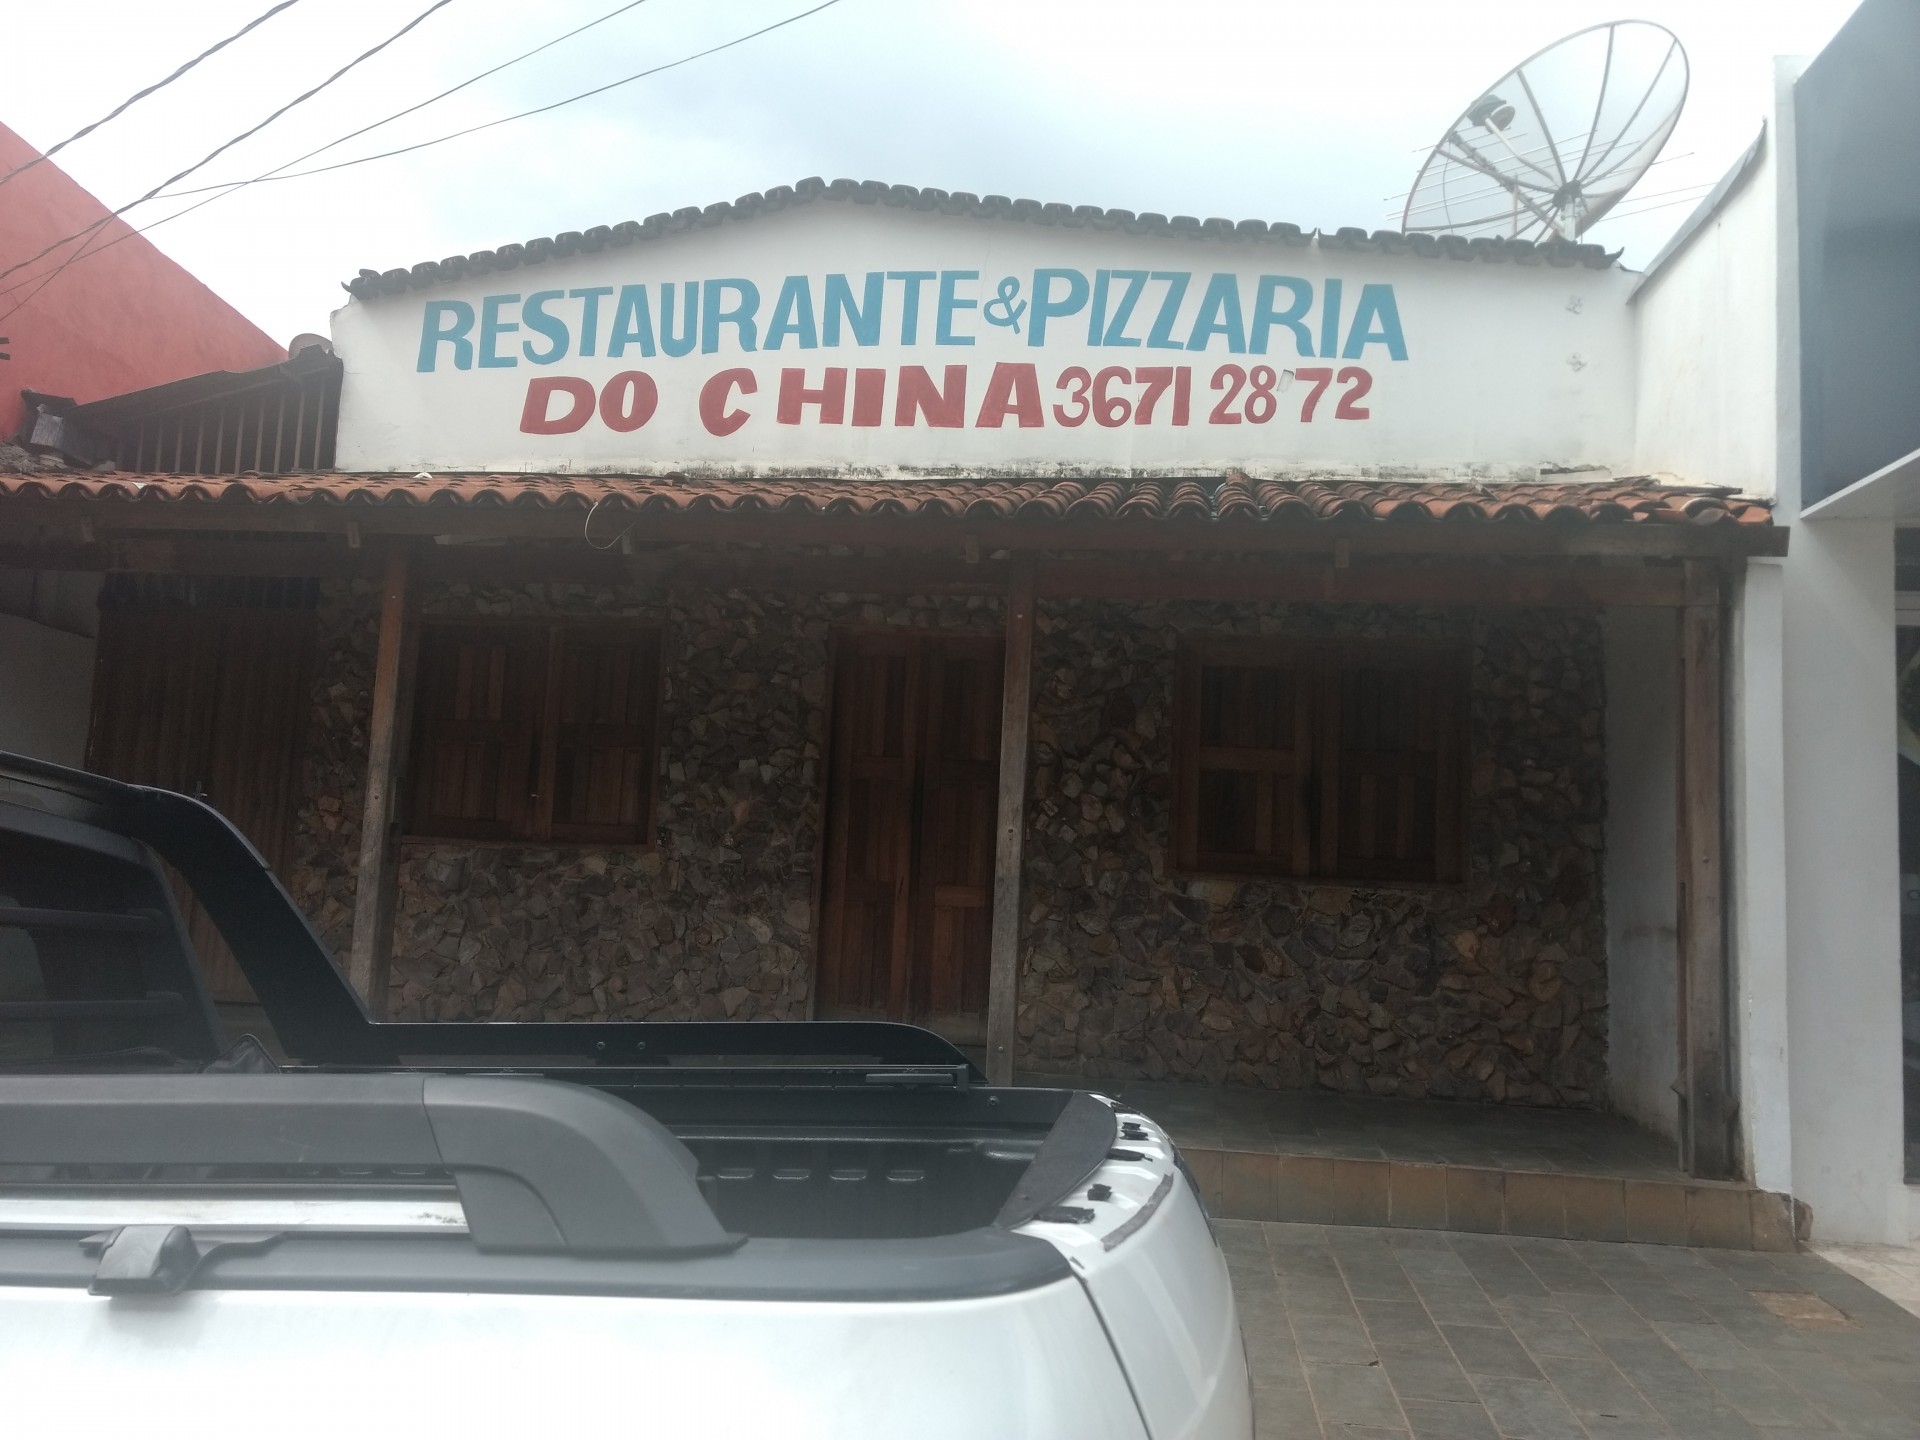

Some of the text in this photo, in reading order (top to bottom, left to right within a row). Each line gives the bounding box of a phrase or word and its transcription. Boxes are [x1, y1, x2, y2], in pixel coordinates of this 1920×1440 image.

[519, 370, 658, 436] DO
[699, 362, 1045, 437] CHINA
[1053, 365, 1191, 428] 3671
